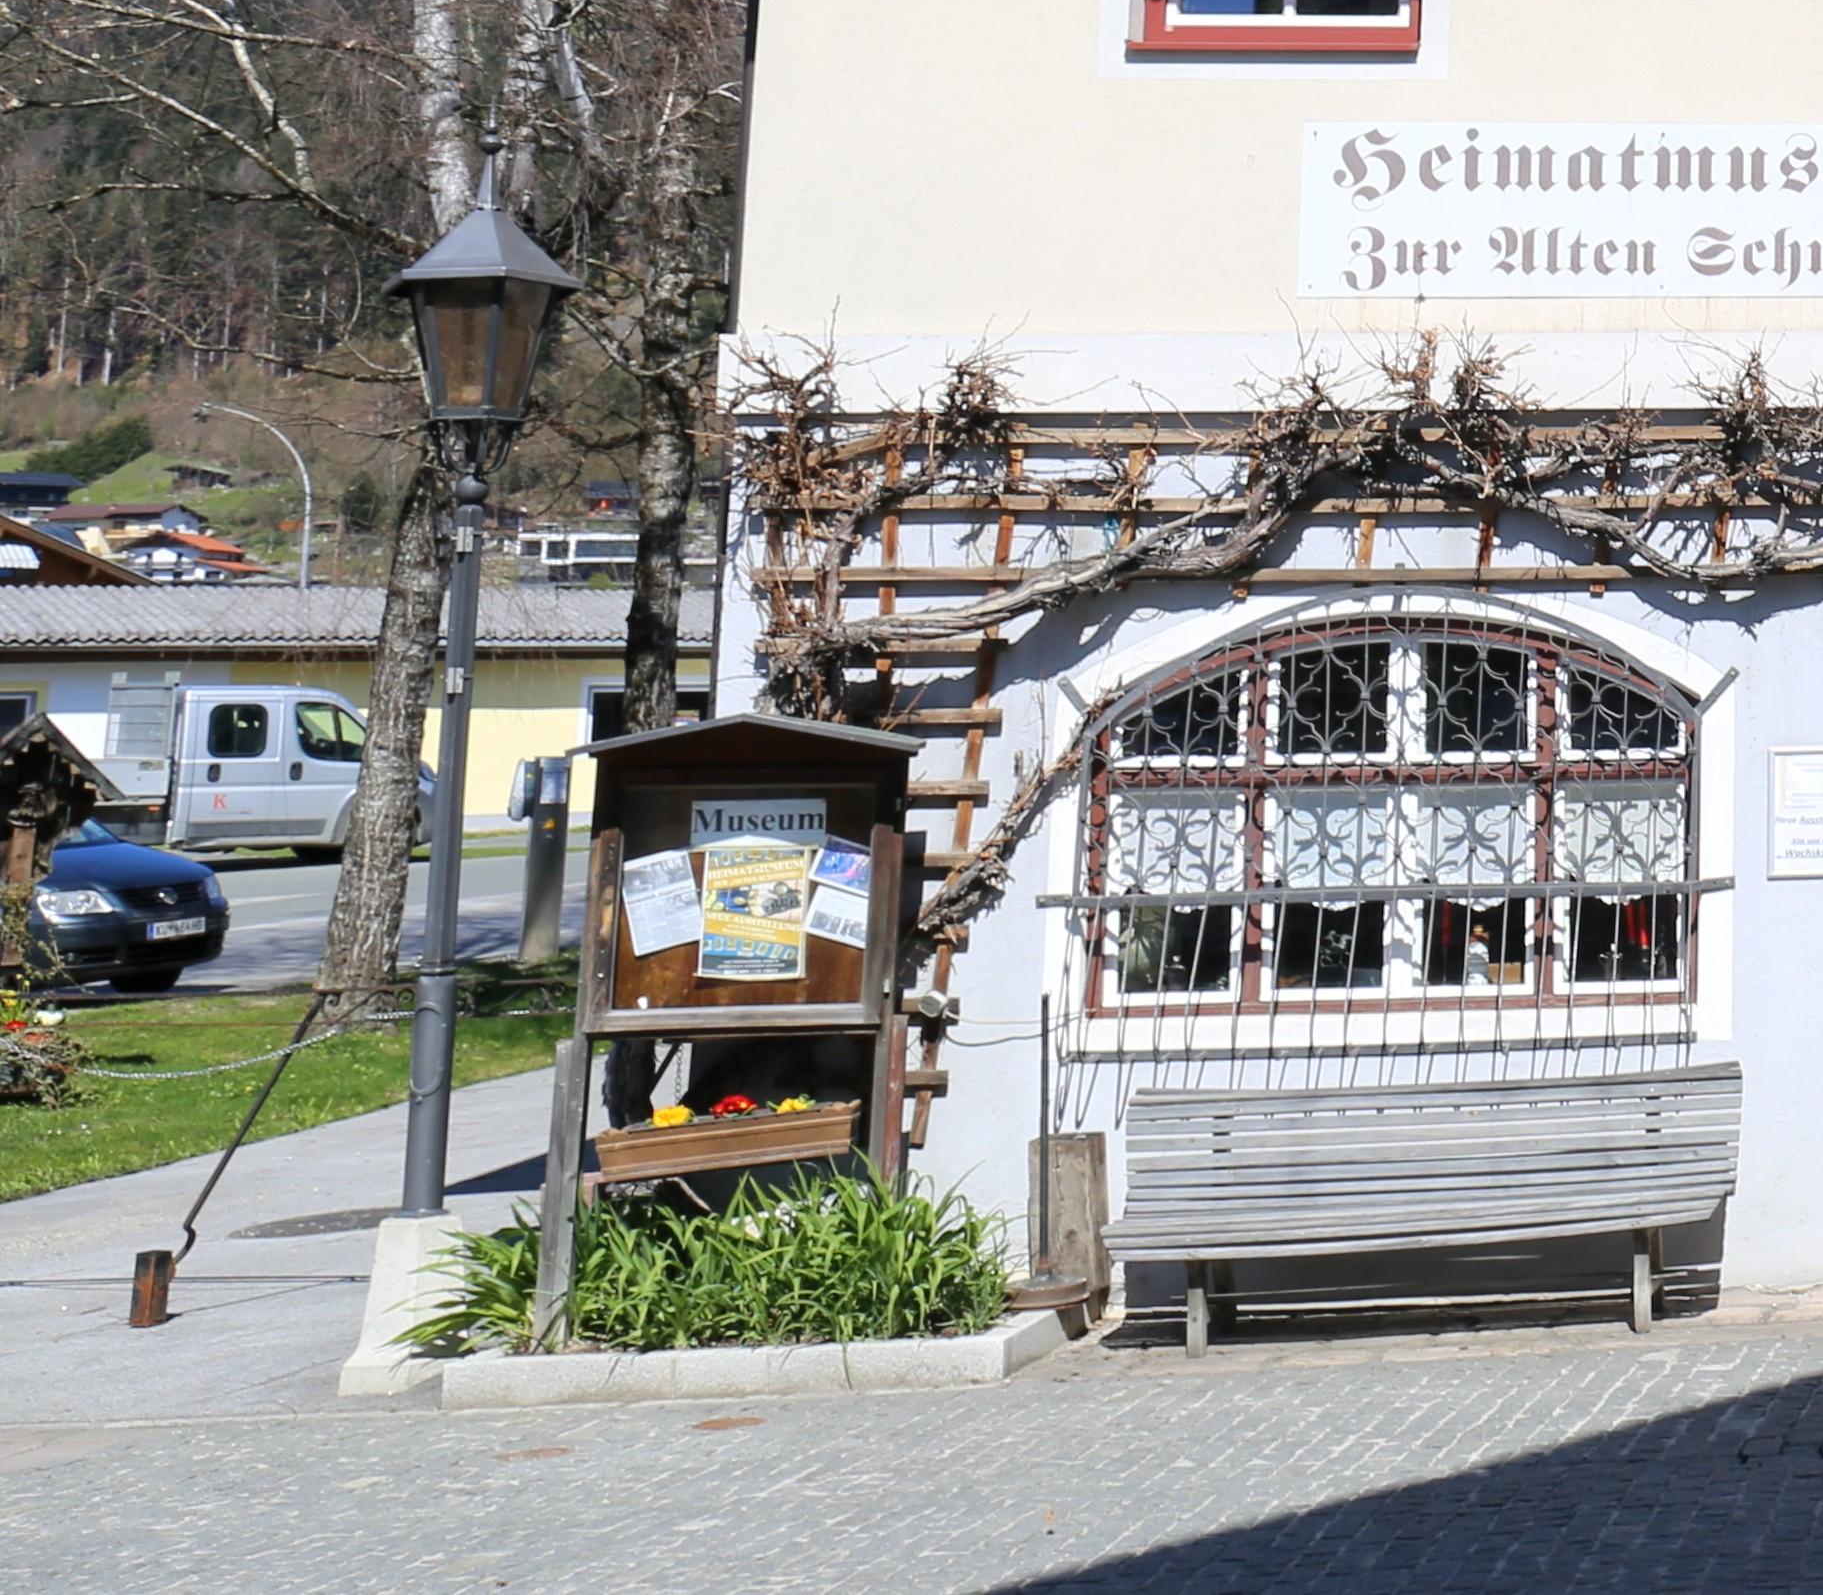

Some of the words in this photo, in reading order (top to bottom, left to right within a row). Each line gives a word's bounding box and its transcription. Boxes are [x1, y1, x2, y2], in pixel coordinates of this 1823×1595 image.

[1340, 225, 1462, 291] Zur
[1487, 225, 1658, 278] Alten
[693, 808, 824, 833] Museum
